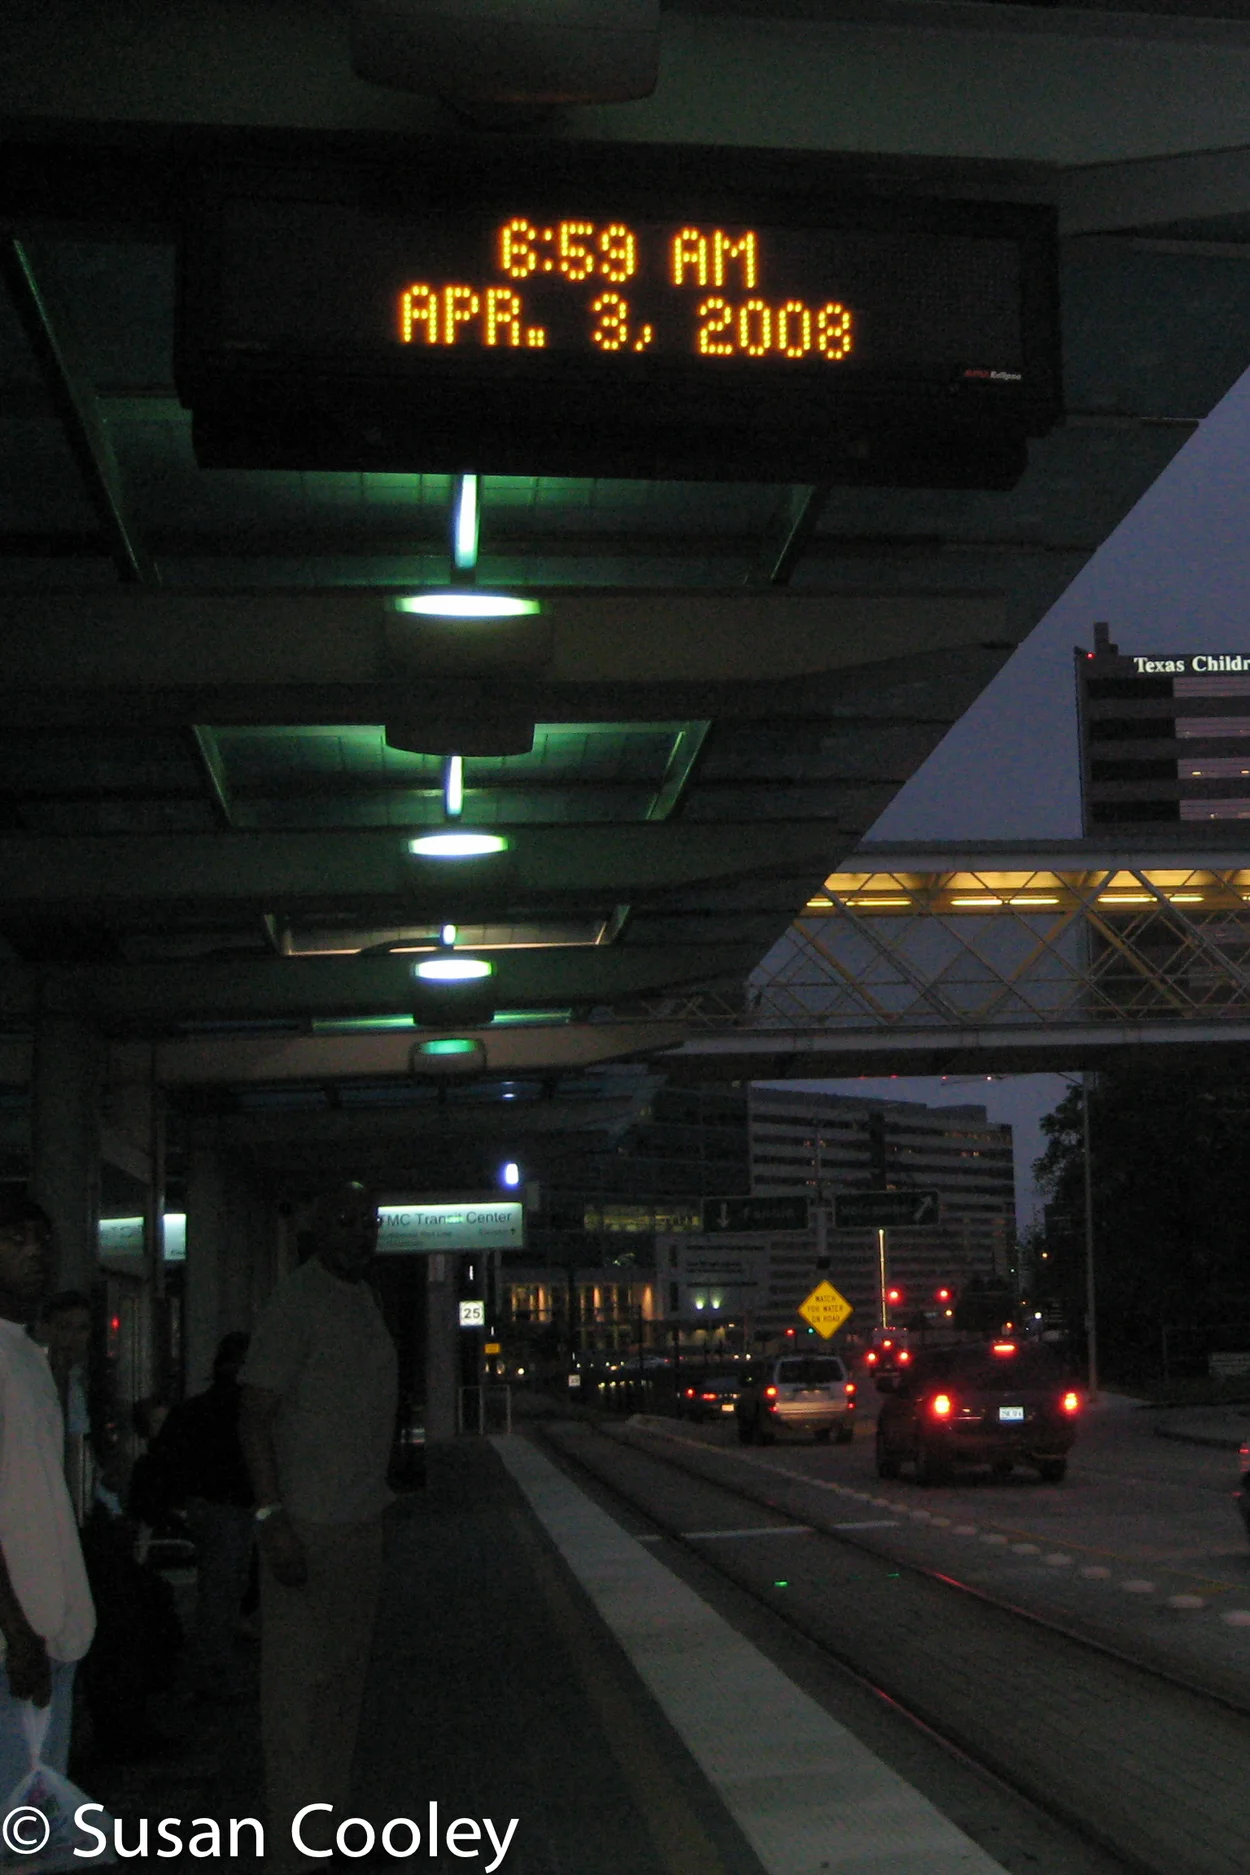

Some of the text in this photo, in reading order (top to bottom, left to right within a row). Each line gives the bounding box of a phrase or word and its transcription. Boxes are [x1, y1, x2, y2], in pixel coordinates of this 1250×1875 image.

[498, 217, 757, 289] 6:59 AM
[398, 283, 852, 361] APR. 3, 2008
[1133, 657, 1185, 673] Texas
[416, 1211, 463, 1225] Transit
[466, 1210, 512, 1225] Center
[815, 1295, 836, 1303] WATCH
[463, 1308, 481, 1319] 25
[823, 1304, 844, 1313] WATER
[823, 1314, 840, 1323] ROAD
